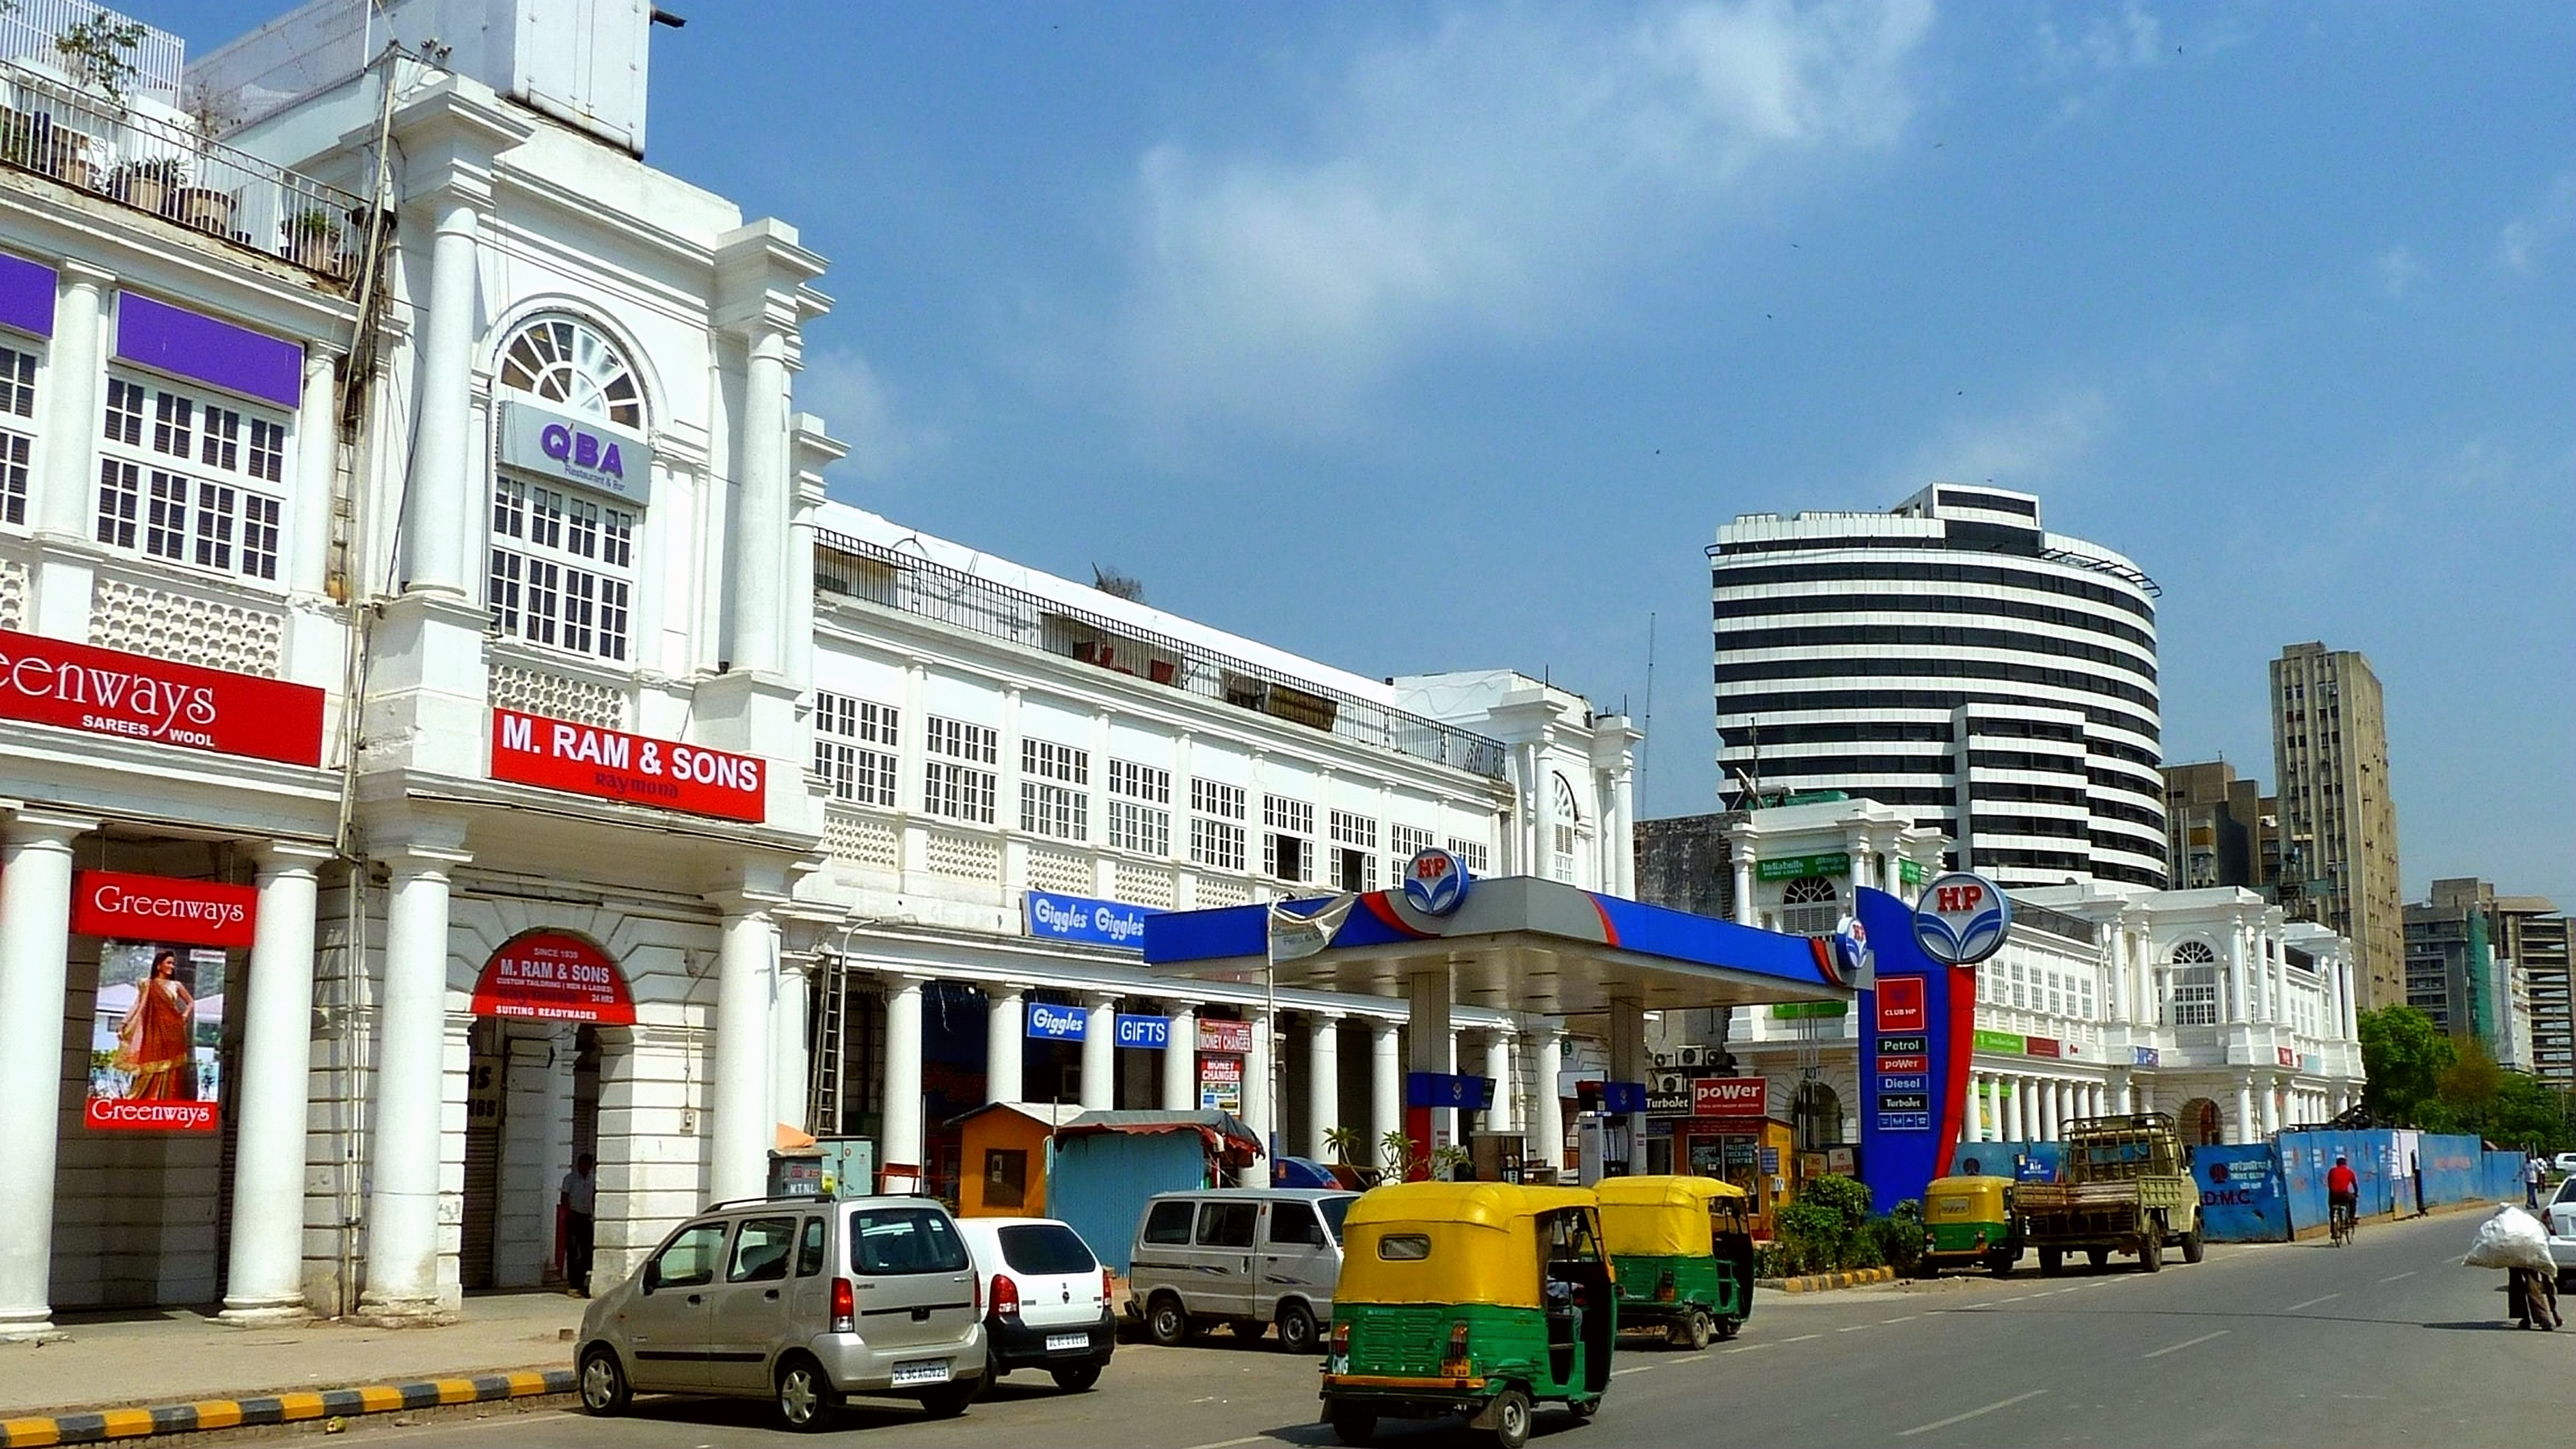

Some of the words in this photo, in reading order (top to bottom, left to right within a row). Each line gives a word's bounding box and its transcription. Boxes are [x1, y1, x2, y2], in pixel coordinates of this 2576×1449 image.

[541, 423, 624, 479] QBA
[0, 656, 217, 737] enways
[82, 714, 150, 737] SAREES
[169, 729, 215, 747] WOOL
[502, 715, 541, 753] M.
[553, 724, 630, 770] RAM
[640, 742, 663, 775] &
[671, 747, 758, 792] SONS
[1418, 856, 1447, 878] HP
[95, 886, 244, 929] Greenways
[1937, 884, 1983, 912] HP
[1034, 898, 1088, 933] Giggles
[1095, 907, 1145, 941] Giggles
[534, 947, 559, 958] SINCE
[501, 959, 517, 976] M.
[522, 960, 552, 979] RAM
[557, 963, 568, 980] &
[572, 964, 609, 984] SONS
[496, 1005, 534, 1015] SUITING
[539, 1008, 597, 1020] READYMADES
[1033, 1009, 1084, 1034] Giggles
[1121, 1021, 1166, 1042] GIFTS
[1885, 1040, 1919, 1051] Petrol
[1202, 1070, 1240, 1081] CHANGER
[1208, 1060, 1235, 1070] MONEY
[1885, 1078, 1920, 1088] Diesel
[92, 1100, 209, 1128] Greenways
